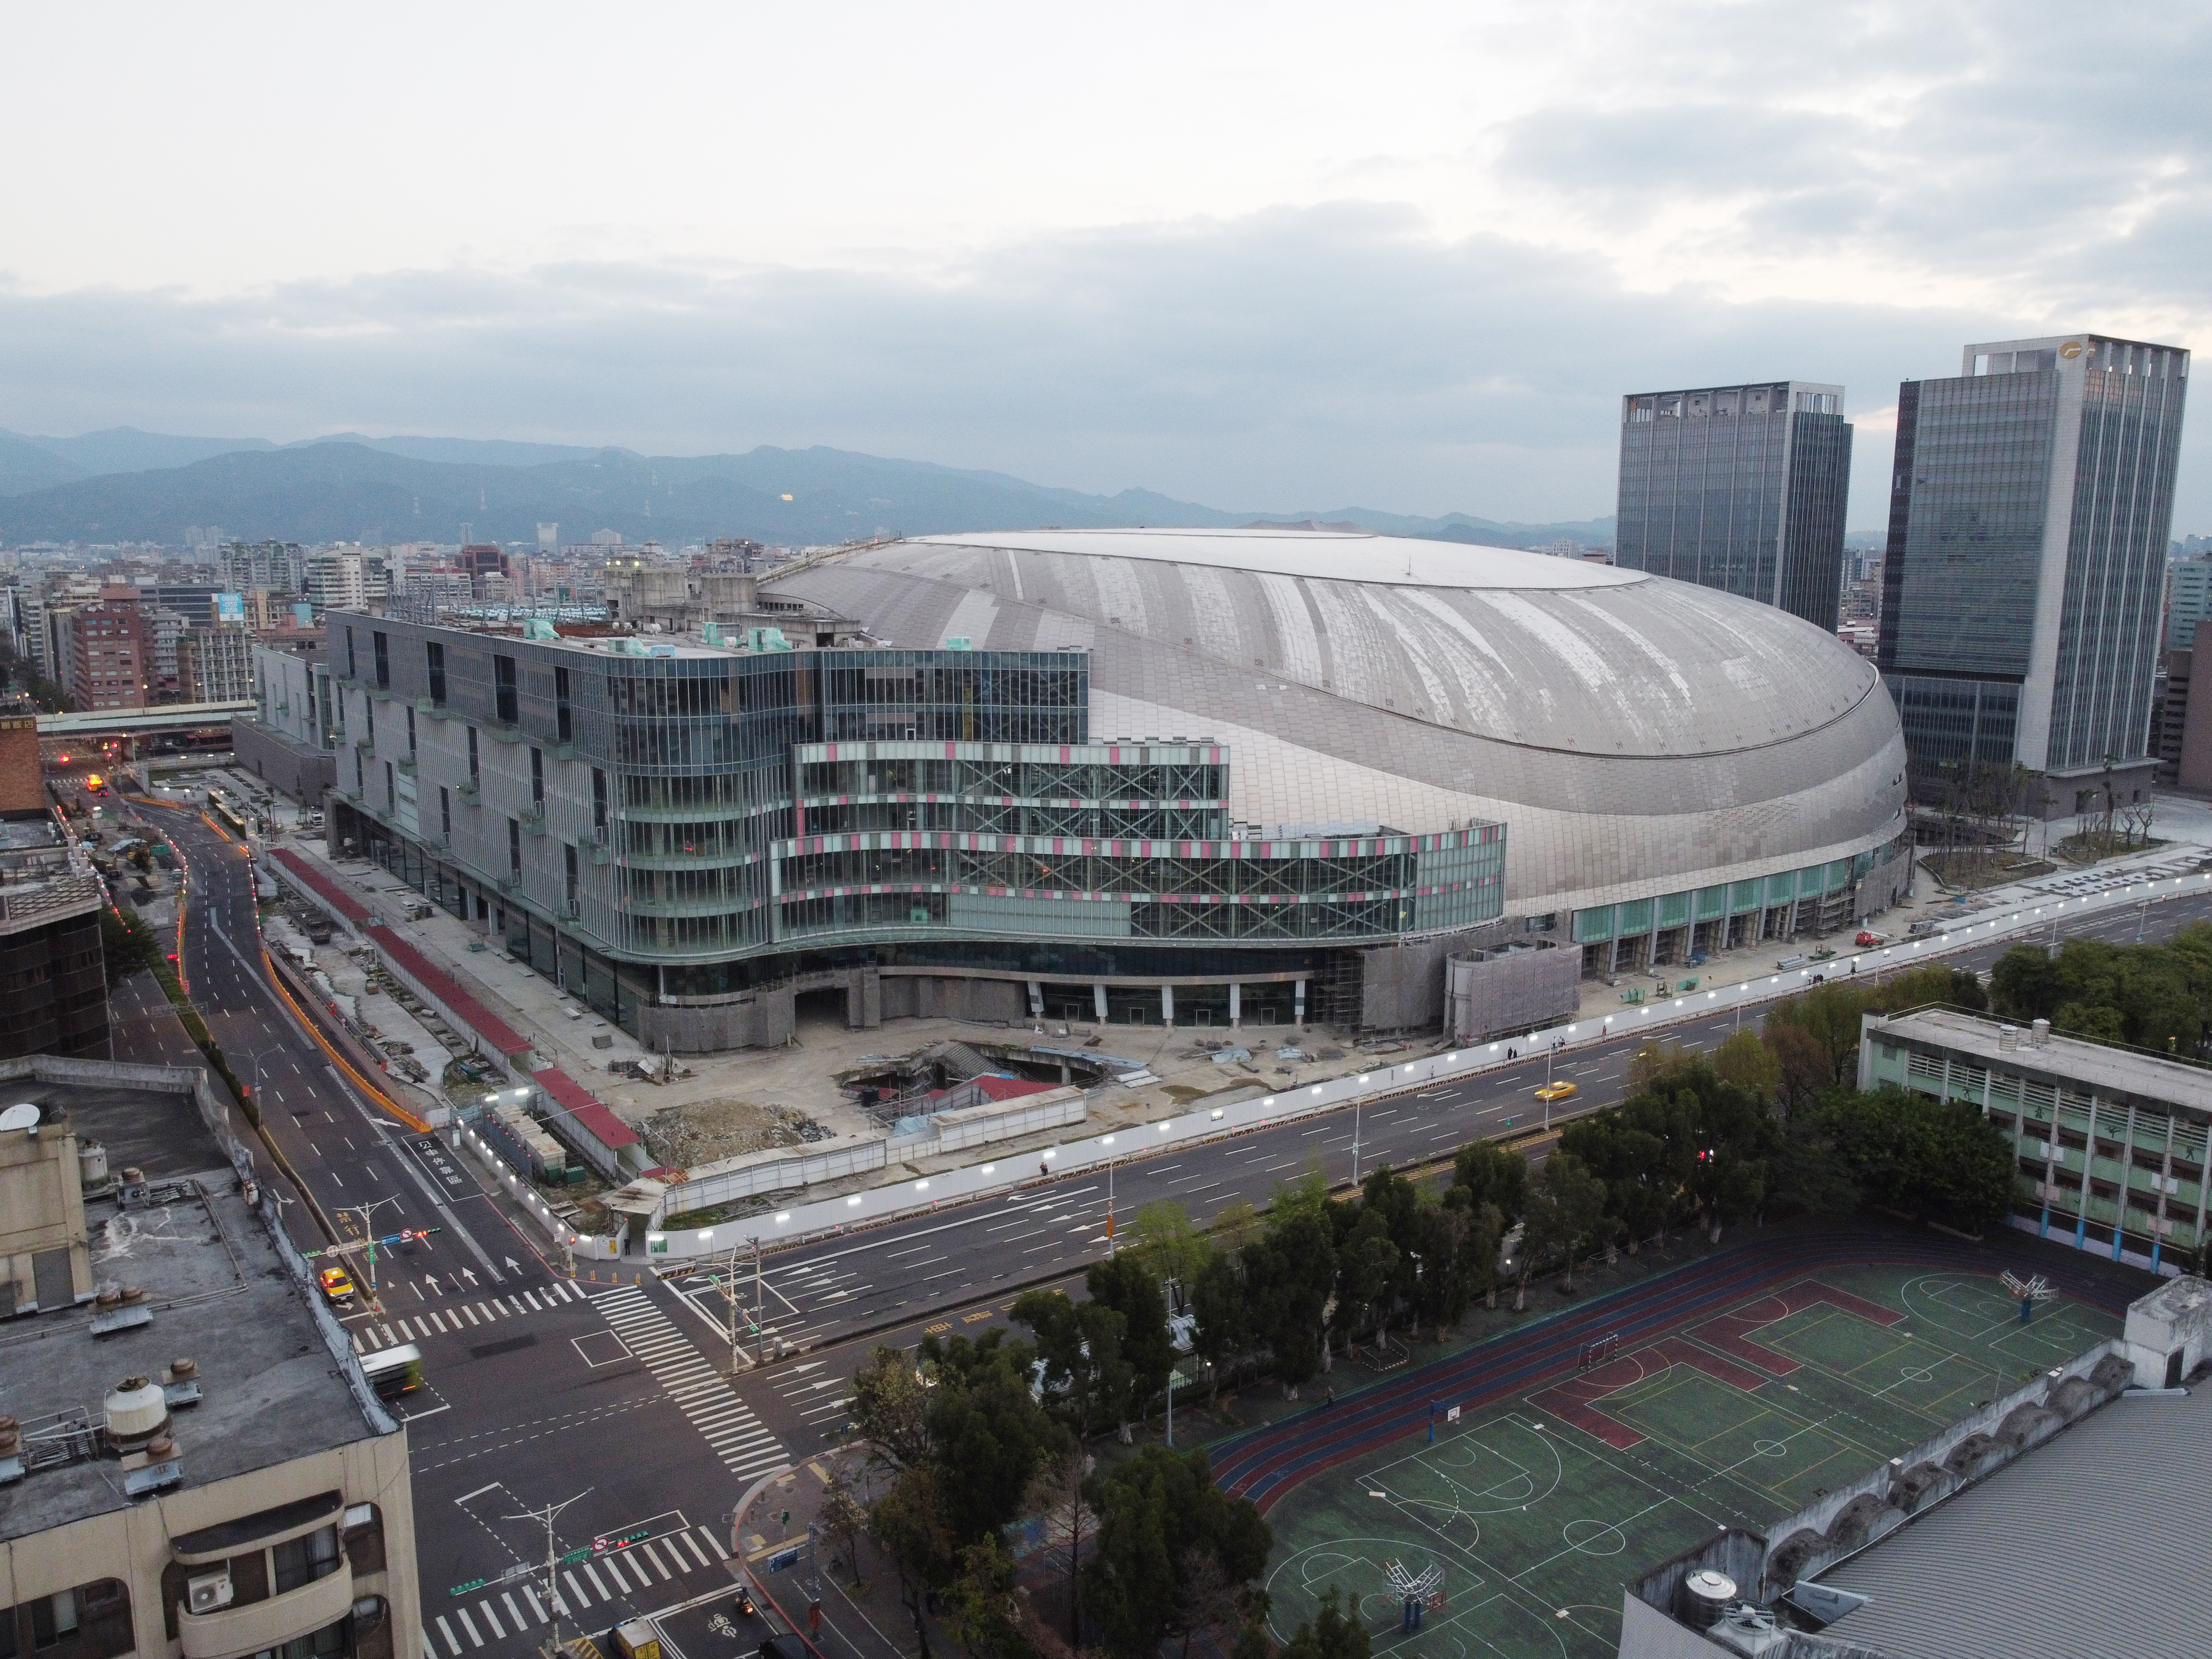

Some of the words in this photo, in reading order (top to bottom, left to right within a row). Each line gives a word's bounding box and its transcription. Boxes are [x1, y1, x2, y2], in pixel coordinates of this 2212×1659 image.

[419, 1140, 463, 1185] 公車停靠區
